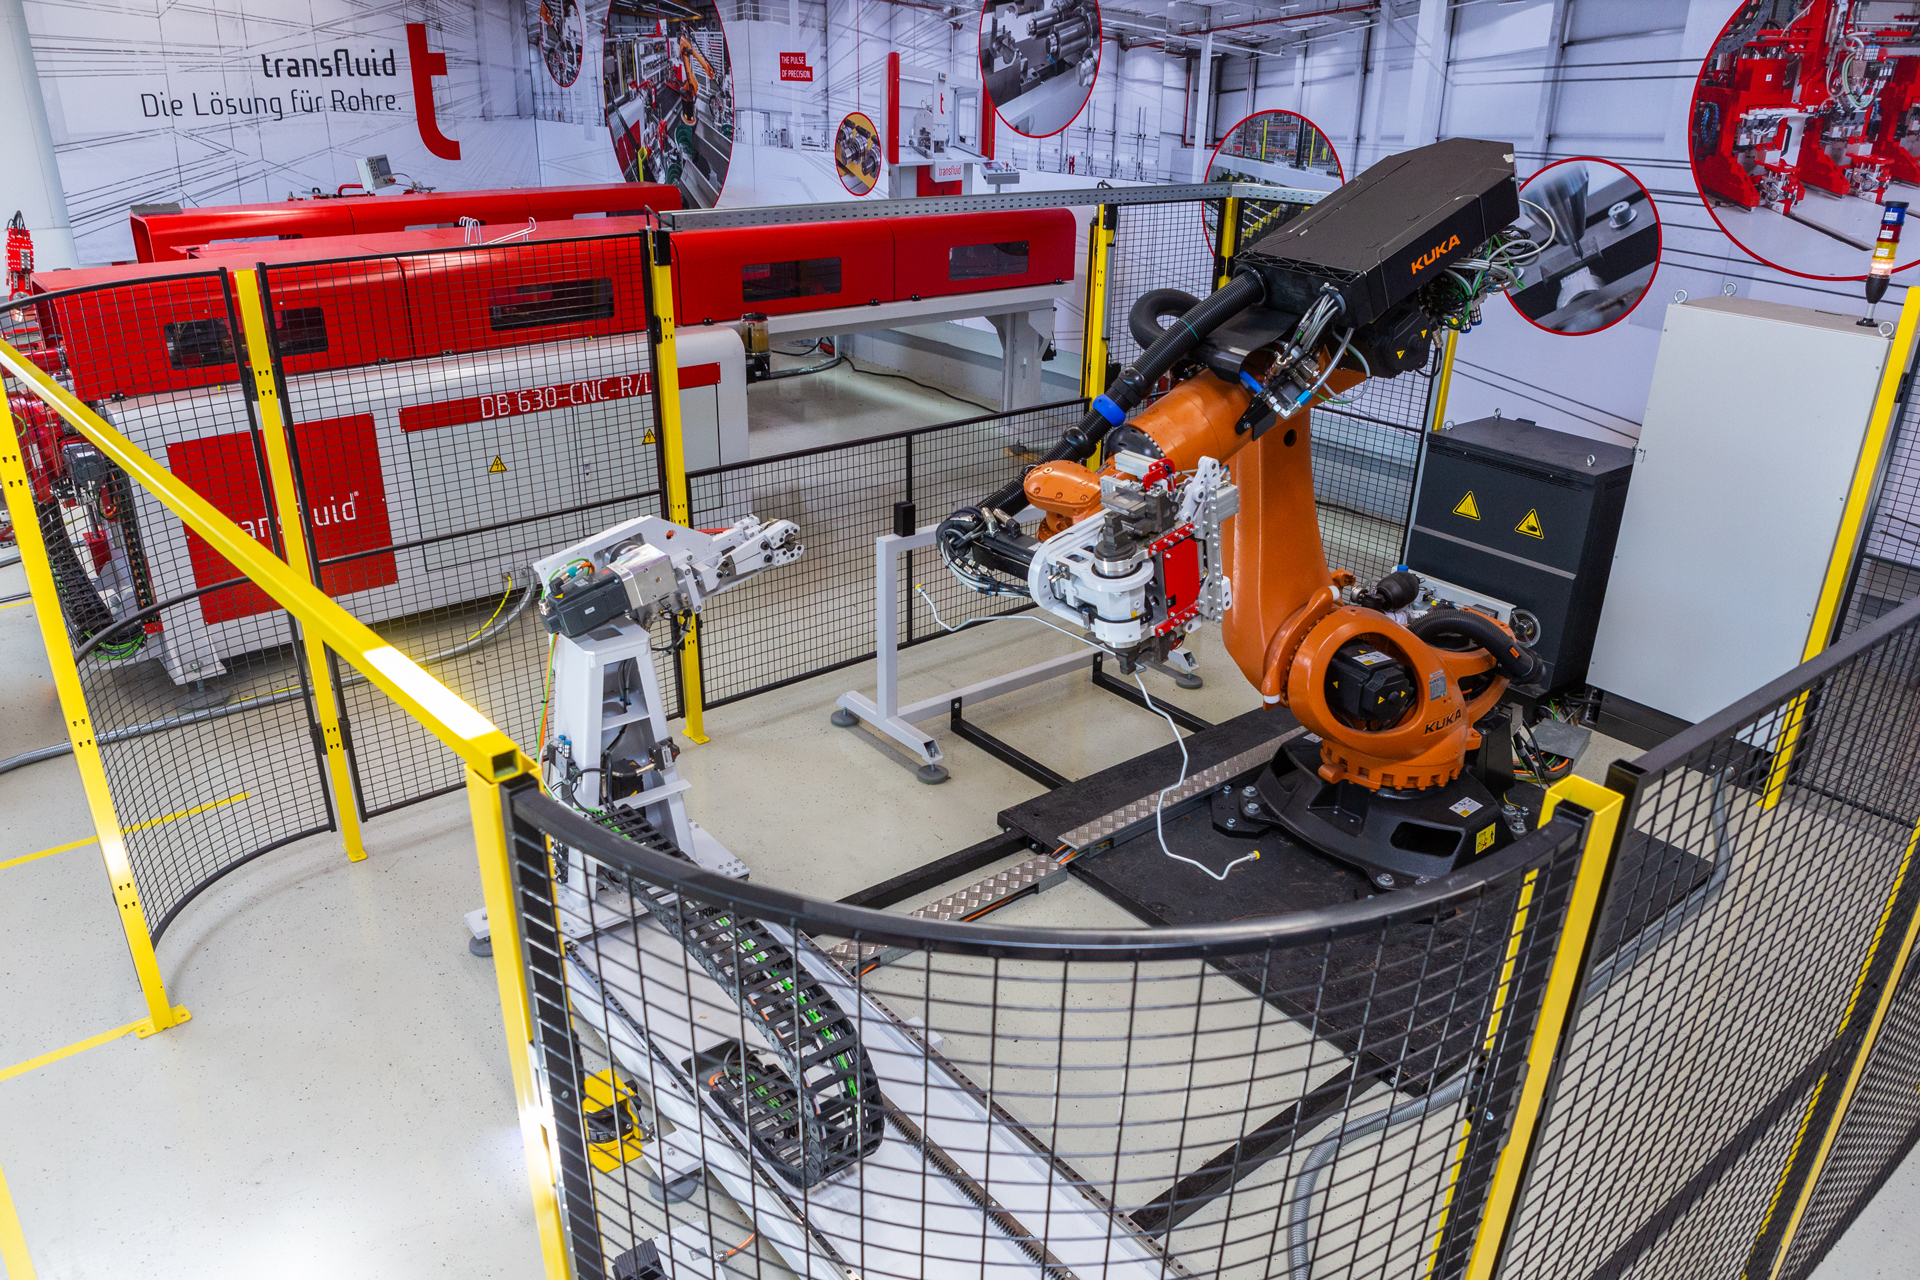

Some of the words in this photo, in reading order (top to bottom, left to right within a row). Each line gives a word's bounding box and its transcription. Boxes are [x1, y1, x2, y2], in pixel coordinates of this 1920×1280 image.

[262, 48, 396, 78] transfluid
[781, 56, 790, 65] THE
[790, 56, 804, 65] PULSE
[782, 69, 788, 78] OF
[788, 69, 811, 79] PRECISION.
[141, 91, 183, 118] Die
[193, 91, 283, 121] Lösung
[291, 88, 323, 113] für
[331, 88, 402, 112] Rohre.
[1411, 234, 1461, 275] KUKA
[480, 394, 511, 419] DB
[518, 372, 652, 412] 630-CNC-R/L
[1424, 708, 1462, 734] KUKA
